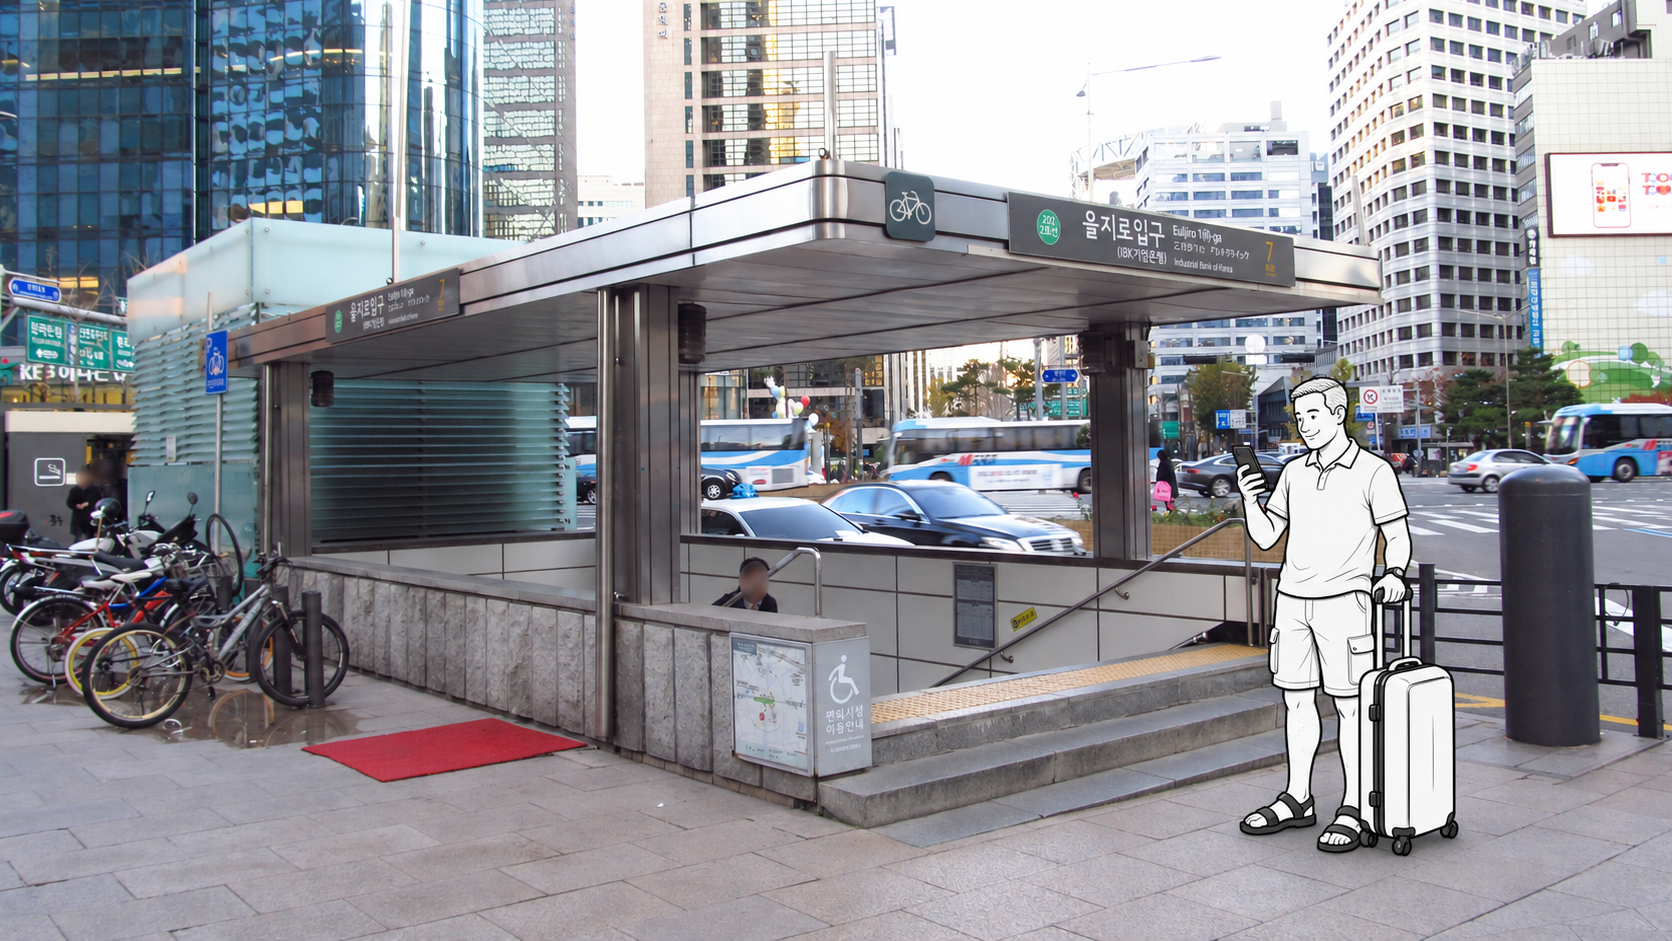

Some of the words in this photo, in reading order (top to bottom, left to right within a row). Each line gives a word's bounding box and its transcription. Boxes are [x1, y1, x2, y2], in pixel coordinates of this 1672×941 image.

[1082, 210, 1165, 248] 을지로입구
[1173, 224, 1196, 240] Euljiro
[1265, 241, 1274, 262] 7
